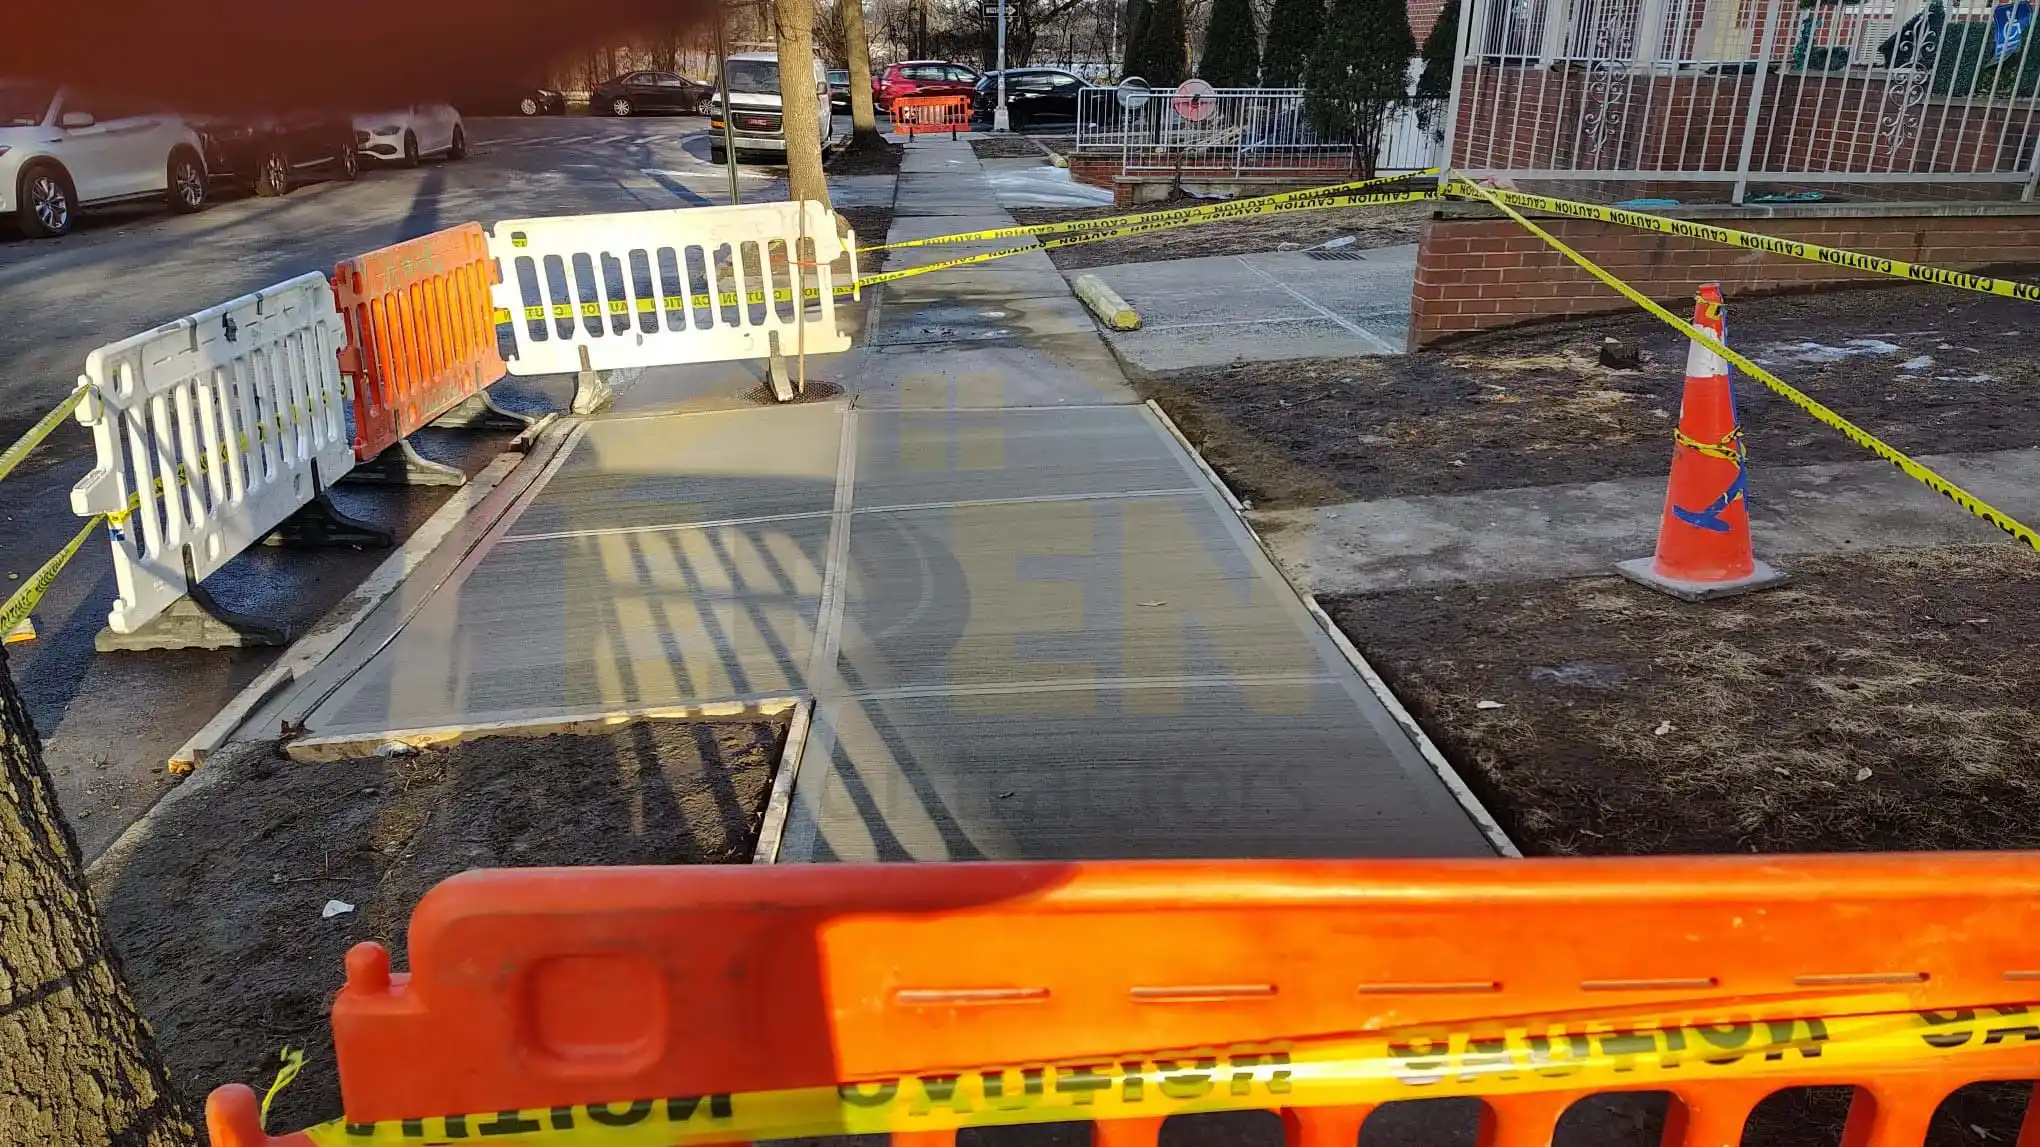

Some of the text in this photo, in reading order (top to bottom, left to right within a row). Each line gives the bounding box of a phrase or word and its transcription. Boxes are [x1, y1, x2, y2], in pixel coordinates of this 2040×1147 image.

[1288, 186, 1350, 202] CAUTION
[1347, 193, 1410, 206] CAUTION
[1505, 193, 1546, 209] CAUTION
[1214, 197, 1275, 213] CAUTION
[1274, 197, 1334, 211] CAUTION
[1554, 201, 1600, 218] CAUTION
[1140, 208, 1201, 222] CAUTION
[1202, 205, 1260, 221] CAUTION
[1610, 211, 1660, 230] CAUTION
[995, 226, 1054, 238] CAUTION
[1067, 218, 1127, 231] CAUTION
[1131, 218, 1189, 233] CAUTION
[1671, 222, 1728, 243] CAUTION
[1060, 229, 1117, 244] CAUTION
[988, 241, 1046, 258] CAUTION
[1740, 234, 1804, 257] CAUTION
[1818, 249, 1892, 273] CAUTION
[1908, 264, 1994, 292] CAUTION
